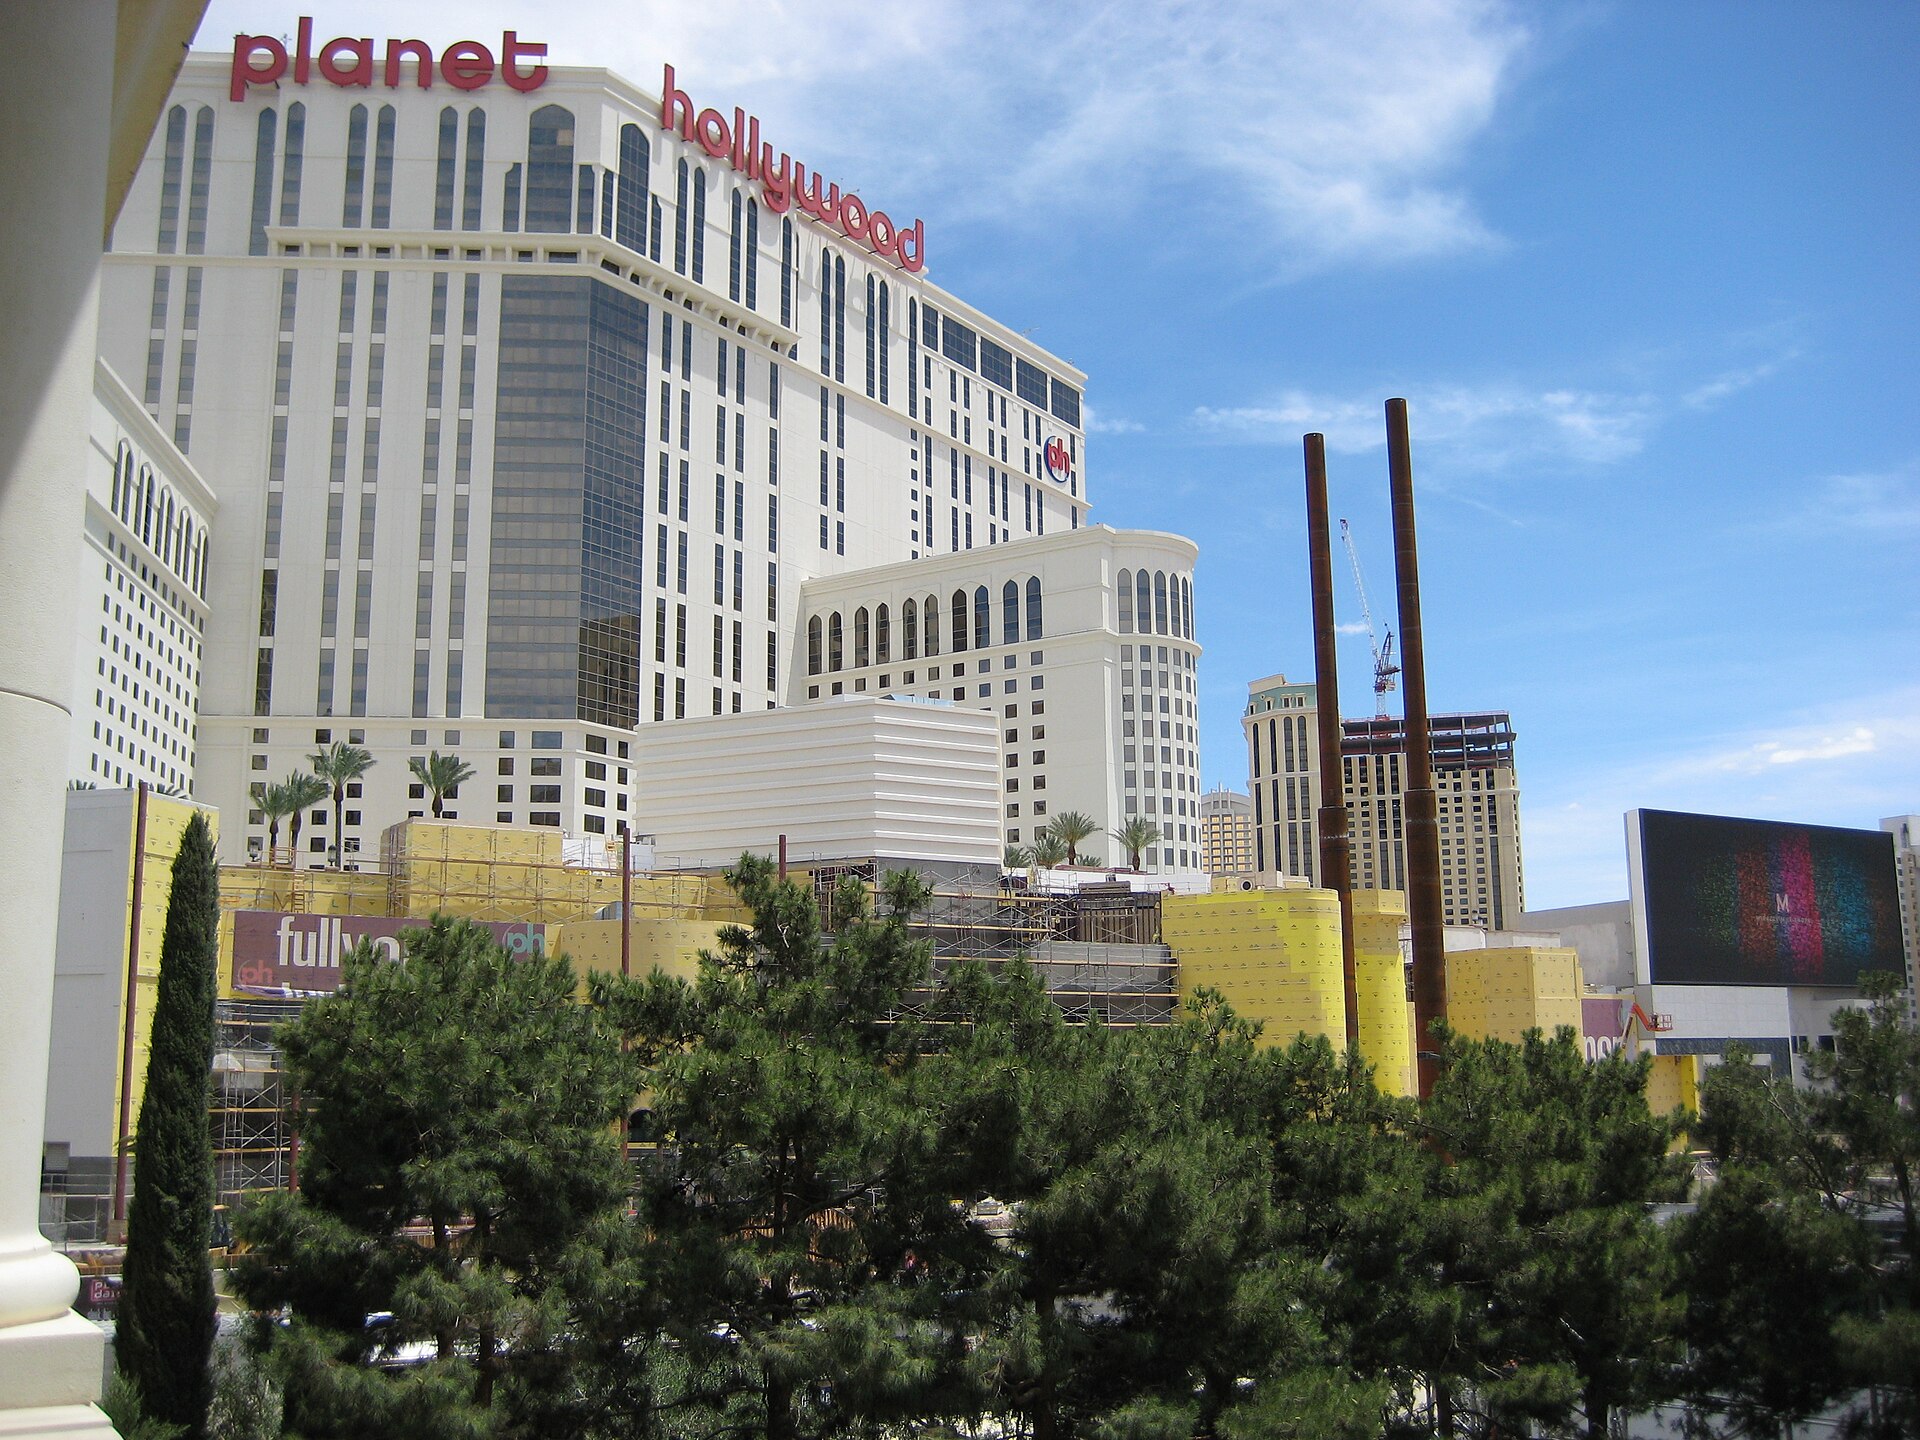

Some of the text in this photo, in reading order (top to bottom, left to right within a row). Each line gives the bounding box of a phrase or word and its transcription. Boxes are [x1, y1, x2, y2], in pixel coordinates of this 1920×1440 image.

[230, 16, 549, 102] planet
[662, 63, 924, 272] hollywood
[1047, 437, 1070, 474] ph
[1775, 893, 1790, 912] M
